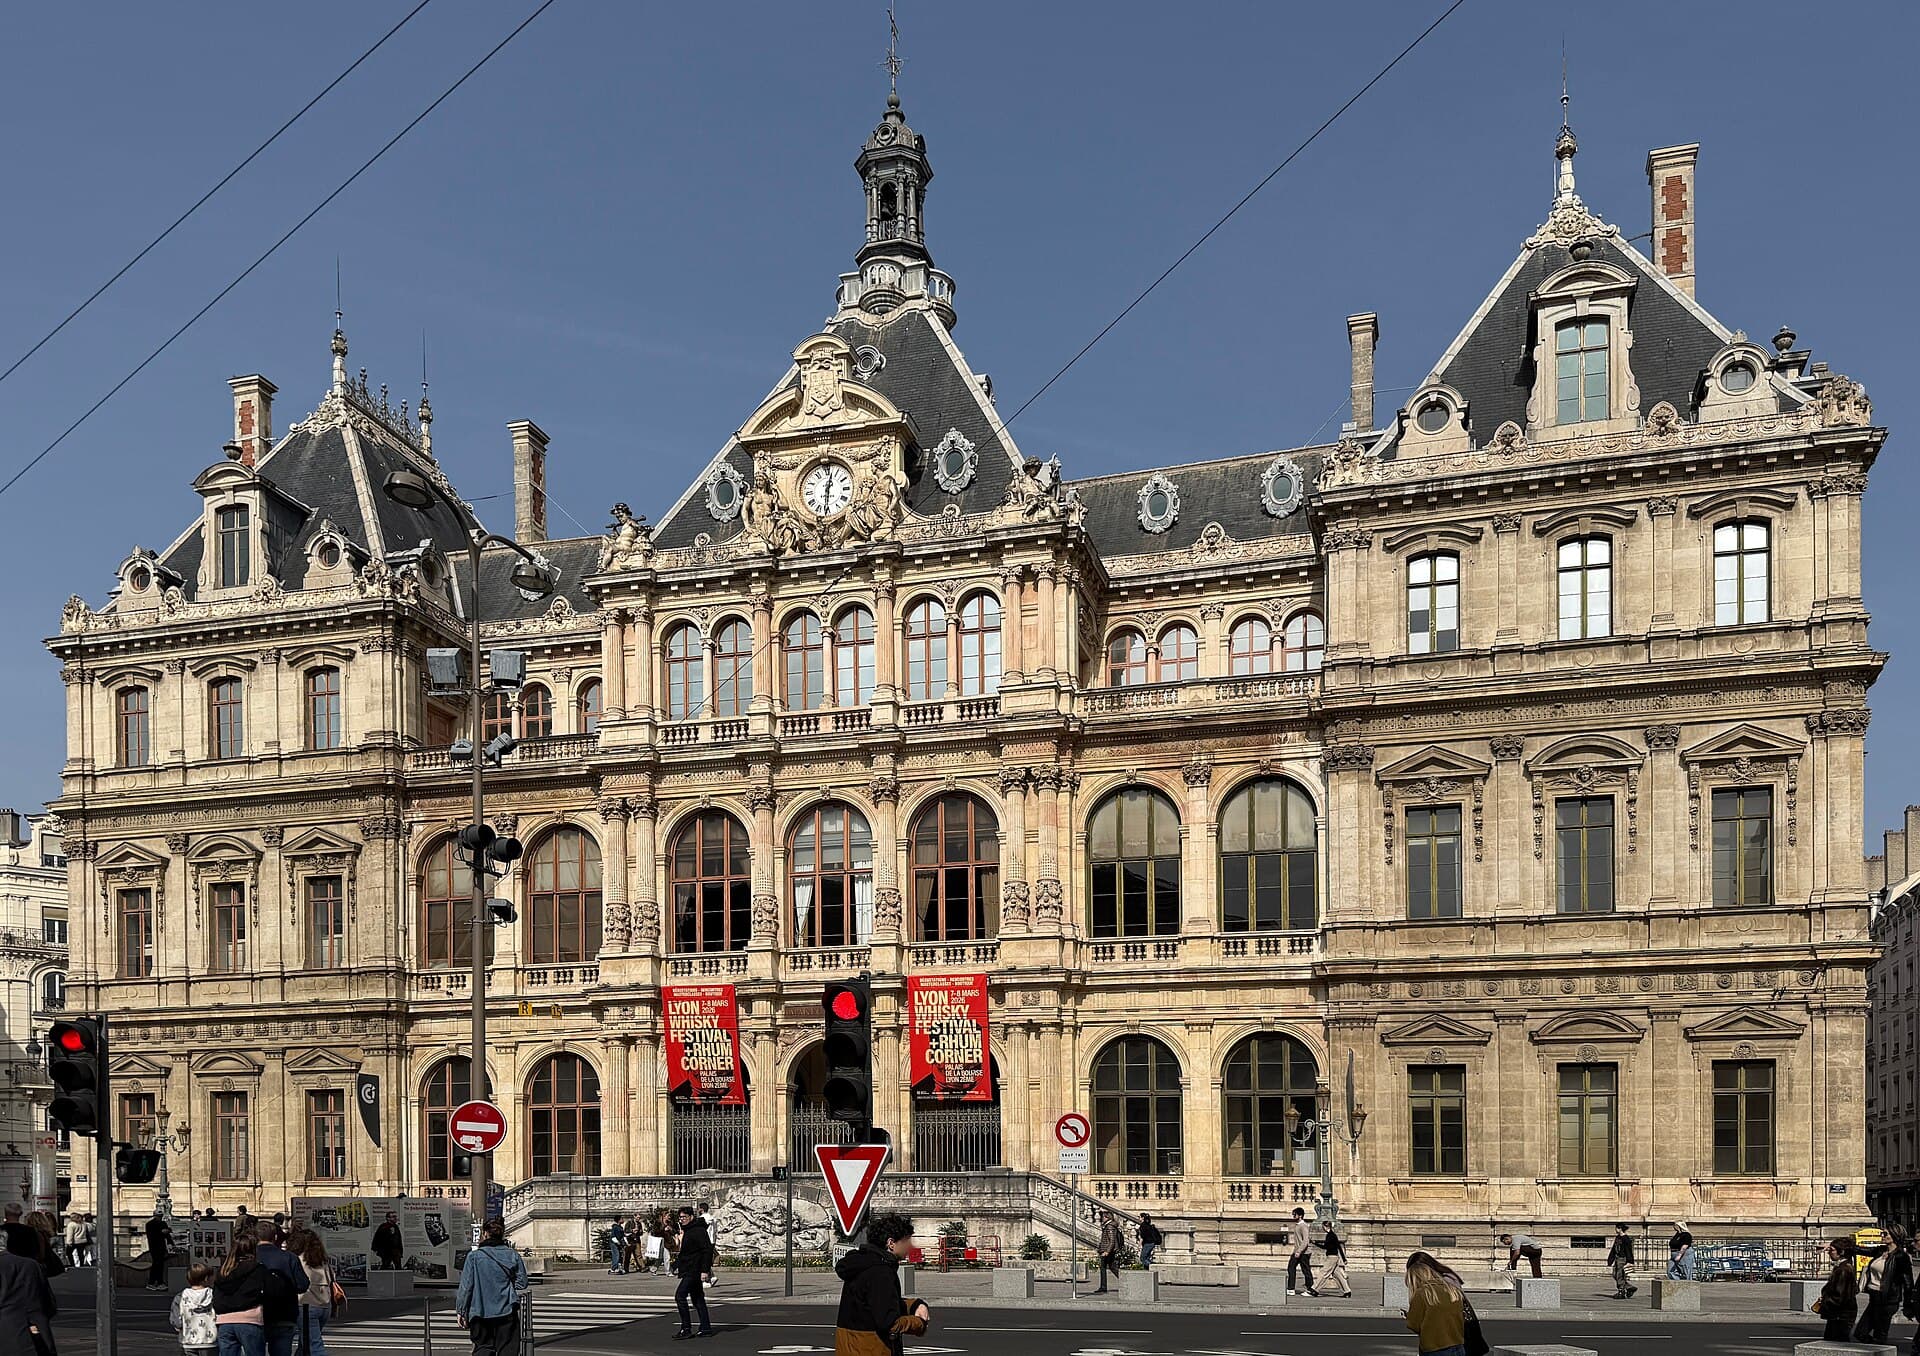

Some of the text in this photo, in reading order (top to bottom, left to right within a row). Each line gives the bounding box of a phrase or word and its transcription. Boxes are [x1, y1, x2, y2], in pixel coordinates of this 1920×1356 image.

[914, 990, 948, 1005] LYON
[961, 989, 980, 997] MARS
[667, 1000, 700, 1015] LYON
[701, 1006, 716, 1014] 2026
[914, 1004, 970, 1020] WHISKY
[669, 1015, 720, 1029] WHISKY
[915, 1019, 981, 1035] FESTIVAL
[670, 1029, 732, 1043] FESTIVAL
[680, 1056, 735, 1071] CORNER
[925, 1048, 983, 1064] CORNER
[961, 1069, 983, 1077] BOURSE
